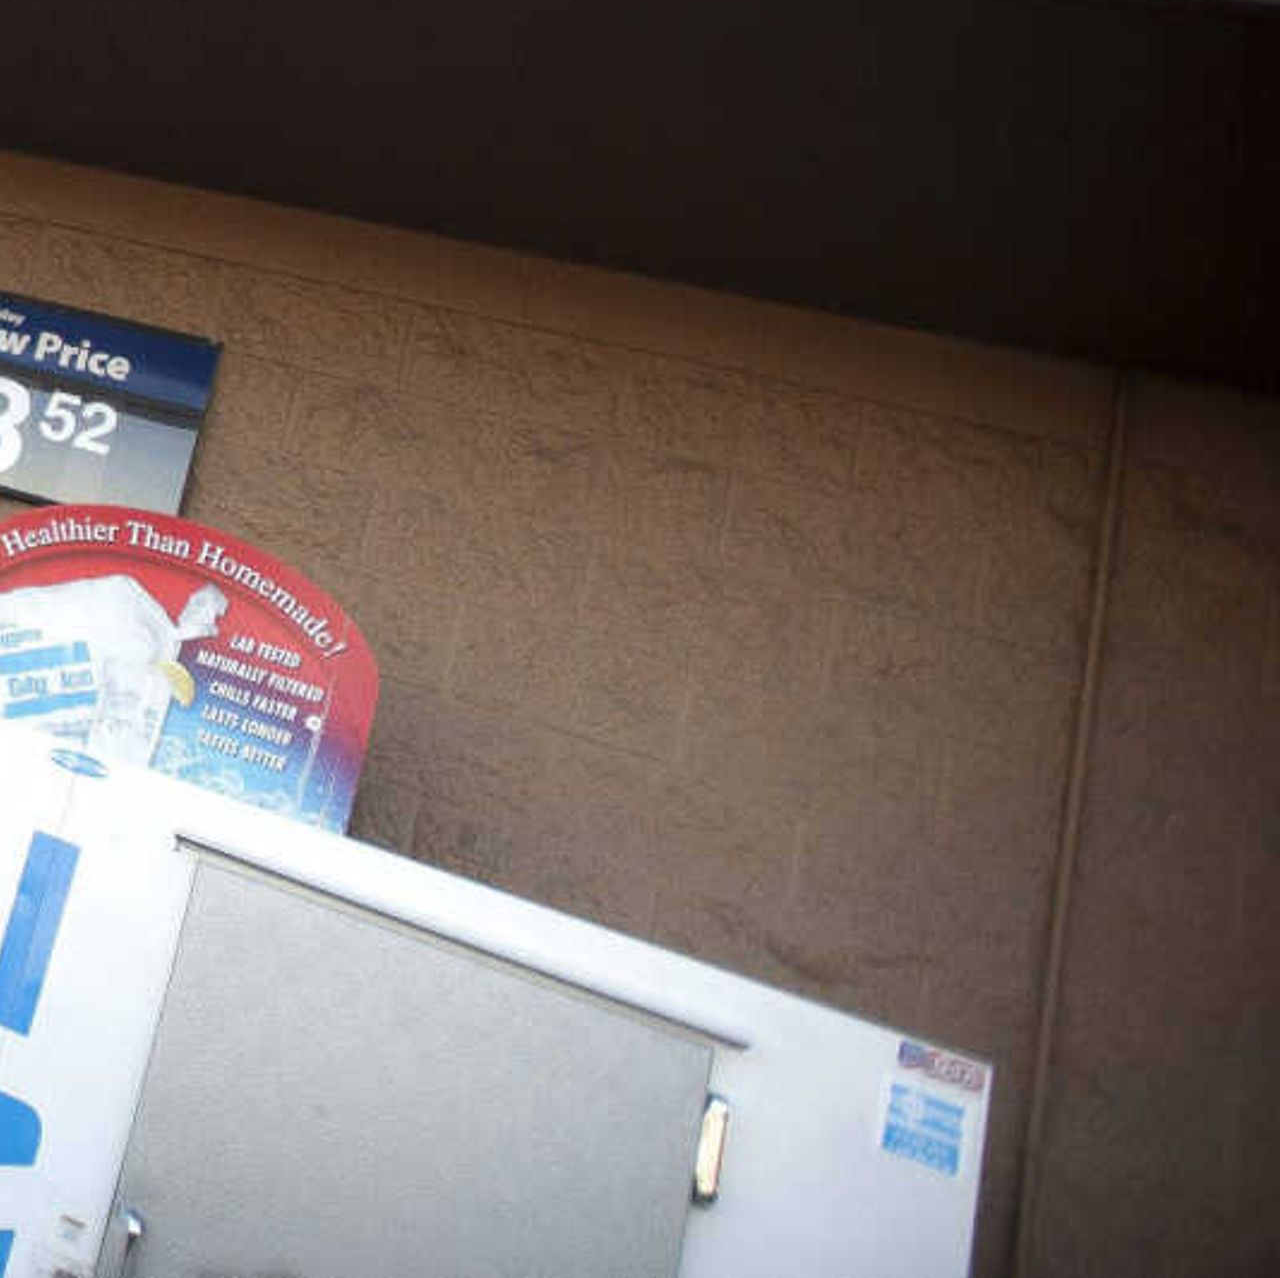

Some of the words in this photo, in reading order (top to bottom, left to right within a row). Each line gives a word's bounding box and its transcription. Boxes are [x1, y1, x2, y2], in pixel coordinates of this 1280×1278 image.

[33, 331, 132, 382] Price
[0, 513, 120, 556] Healthier
[127, 520, 192, 559] Than
[197, 542, 346, 661] Homemade!
[229, 633, 256, 654] LAB
[257, 641, 303, 669] TESTED
[196, 648, 269, 686] NATURALLY
[267, 672, 326, 703] FILTERED
[209, 680, 252, 707] CHILLS
[252, 690, 298, 723] FASTER
[201, 704, 240, 730] LASTS
[240, 716, 293, 747] LONGER
